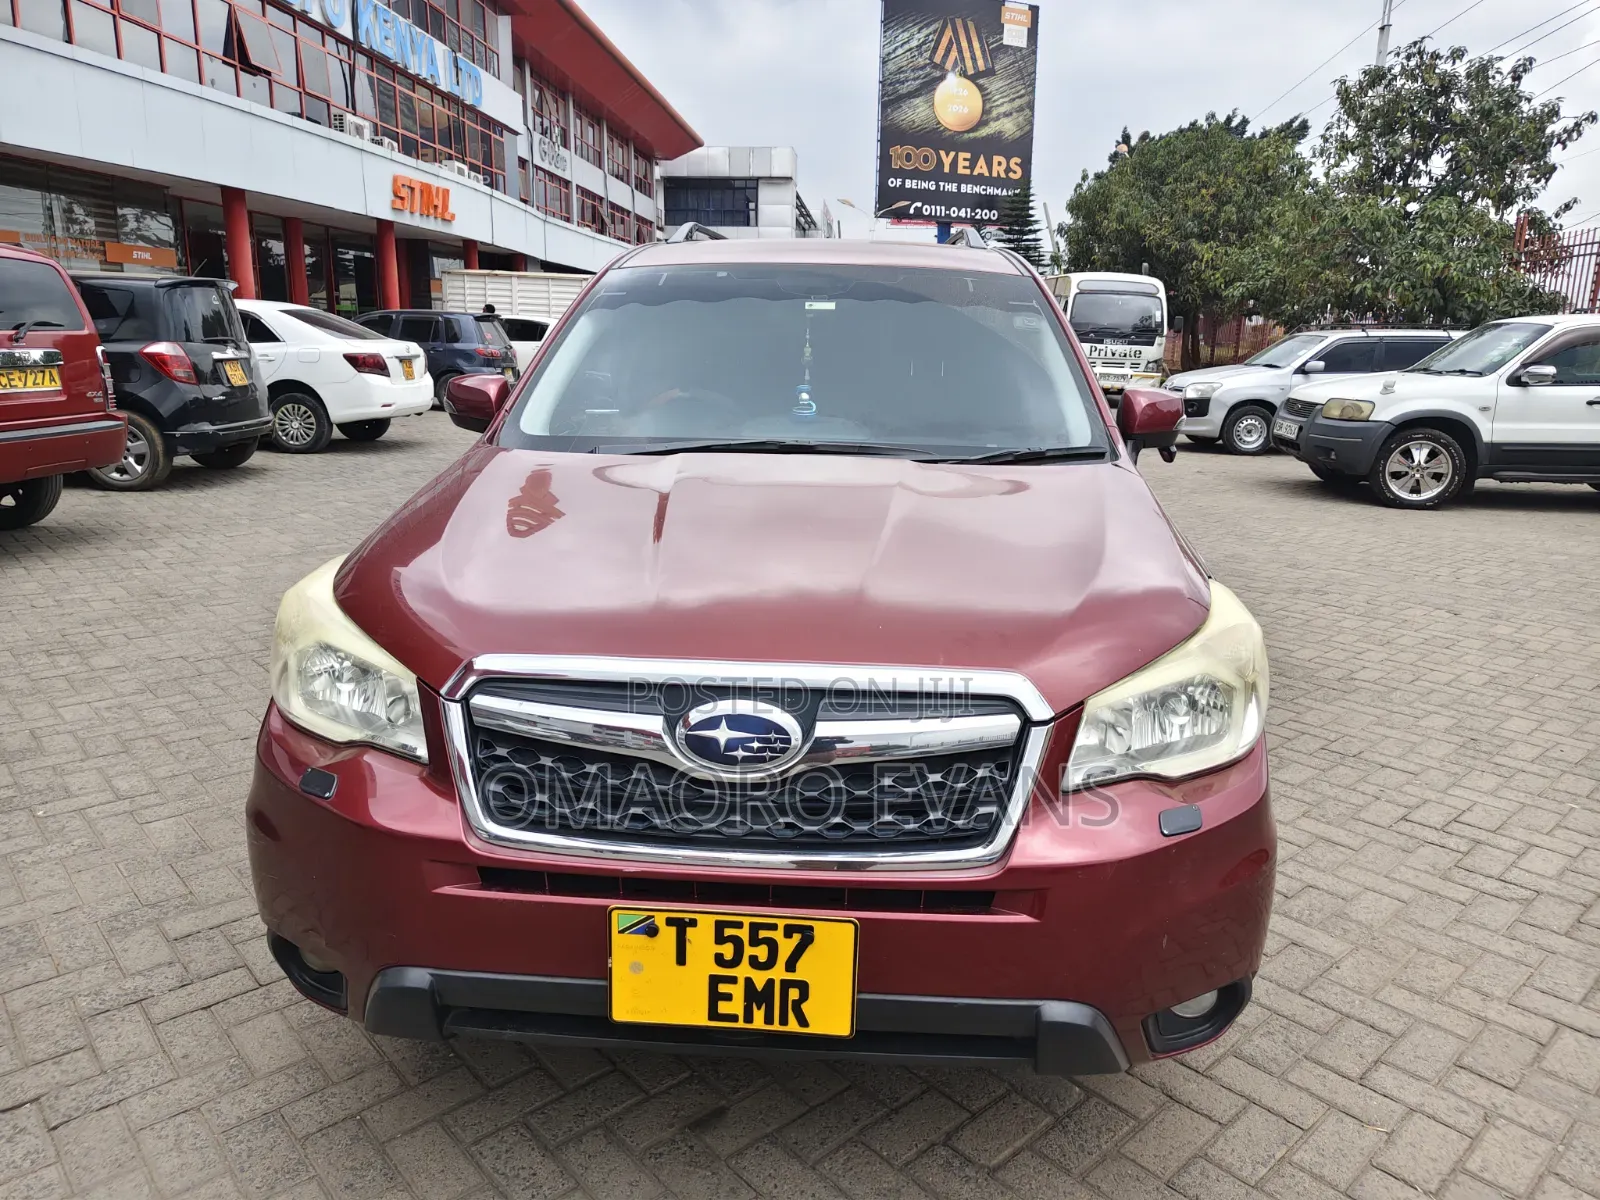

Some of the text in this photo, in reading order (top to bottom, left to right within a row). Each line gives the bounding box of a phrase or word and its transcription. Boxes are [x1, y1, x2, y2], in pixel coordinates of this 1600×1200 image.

[1004, 11, 1028, 22] STIHL
[357, 0, 441, 86] KENYA
[446, 48, 483, 108] LTD
[947, 104, 969, 114] 2026
[890, 145, 1023, 180] 100 YEARS
[888, 178, 902, 188] OF
[905, 179, 936, 190] BEING
[939, 182, 958, 192] THE
[922, 204, 998, 220] 0111-041-200
[132, 250, 152, 260] STIHL
[1089, 345, 1142, 358] Private
[21, 370, 58, 386] 727A
[665, 916, 815, 973] T 557
[707, 973, 811, 1028] EMR
